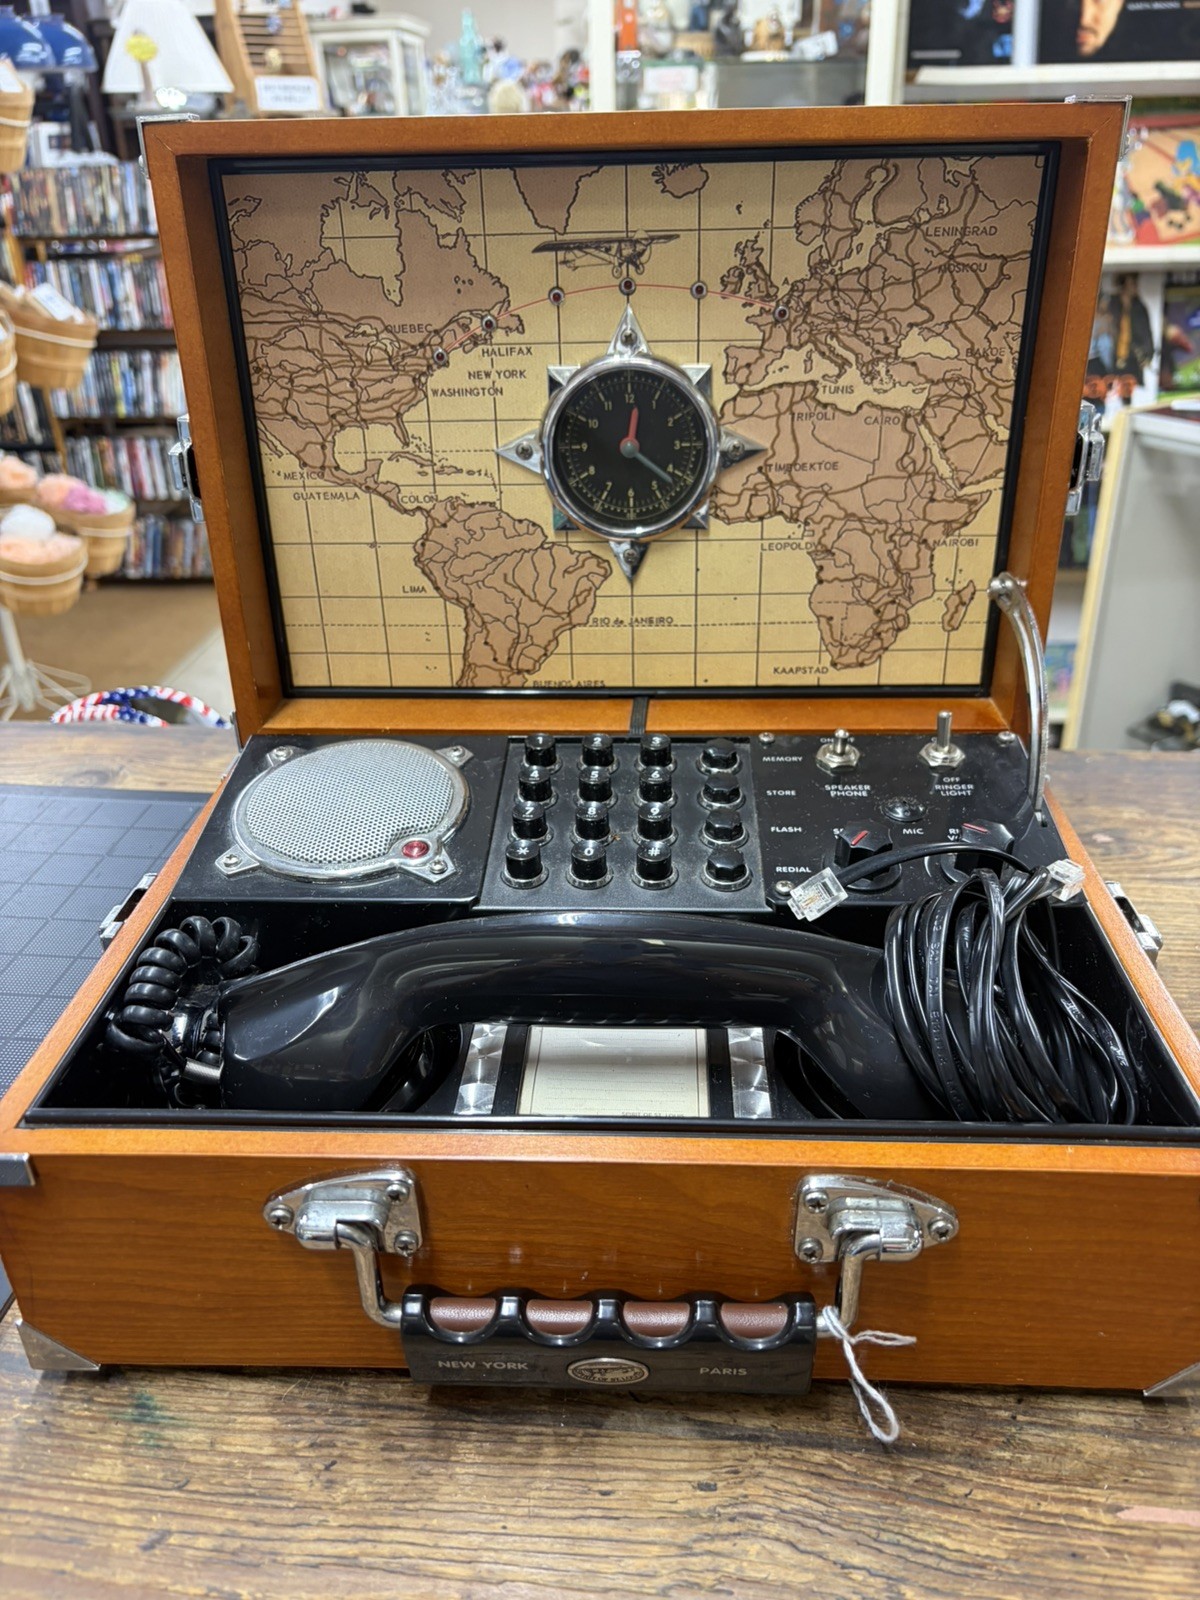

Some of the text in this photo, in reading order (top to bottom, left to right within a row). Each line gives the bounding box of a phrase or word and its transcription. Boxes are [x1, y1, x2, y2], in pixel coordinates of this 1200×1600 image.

[925, 226, 998, 237] LENINGRAD
[385, 323, 433, 334] QUEBEC
[481, 346, 534, 358] HALIFAX
[467, 369, 527, 380] NEW YORK
[430, 386, 504, 398] WASHINGTON
[821, 385, 855, 395] TUNIS
[624, 394, 635, 404] 12
[790, 411, 836, 422] TRIPOLI
[863, 416, 901, 426] CAIRO
[588, 419, 599, 429] 10
[667, 418, 674, 427] 2
[581, 443, 588, 452] 9
[673, 440, 681, 450] 3
[588, 466, 596, 475] 8
[666, 463, 674, 473] 4
[283, 471, 325, 481] MEXICO
[606, 481, 612, 491] 7
[651, 481, 658, 490] 5
[293, 491, 360, 501] GUATEMALA
[628, 488, 635, 497] 6
[401, 494, 438, 504] COLON
[932, 538, 979, 548] NAIROBI
[402, 585, 428, 594] LIMA
[591, 616, 611, 626] RIO
[629, 616, 674, 626] JANEIRO
[772, 666, 829, 675] KAAPSTAD
[525, 807, 534, 815] 7
[587, 807, 596, 815] 8
[650, 807, 660, 815] 9
[437, 1360, 529, 1371] NEW YORK
[699, 1366, 748, 1376] PARIS
